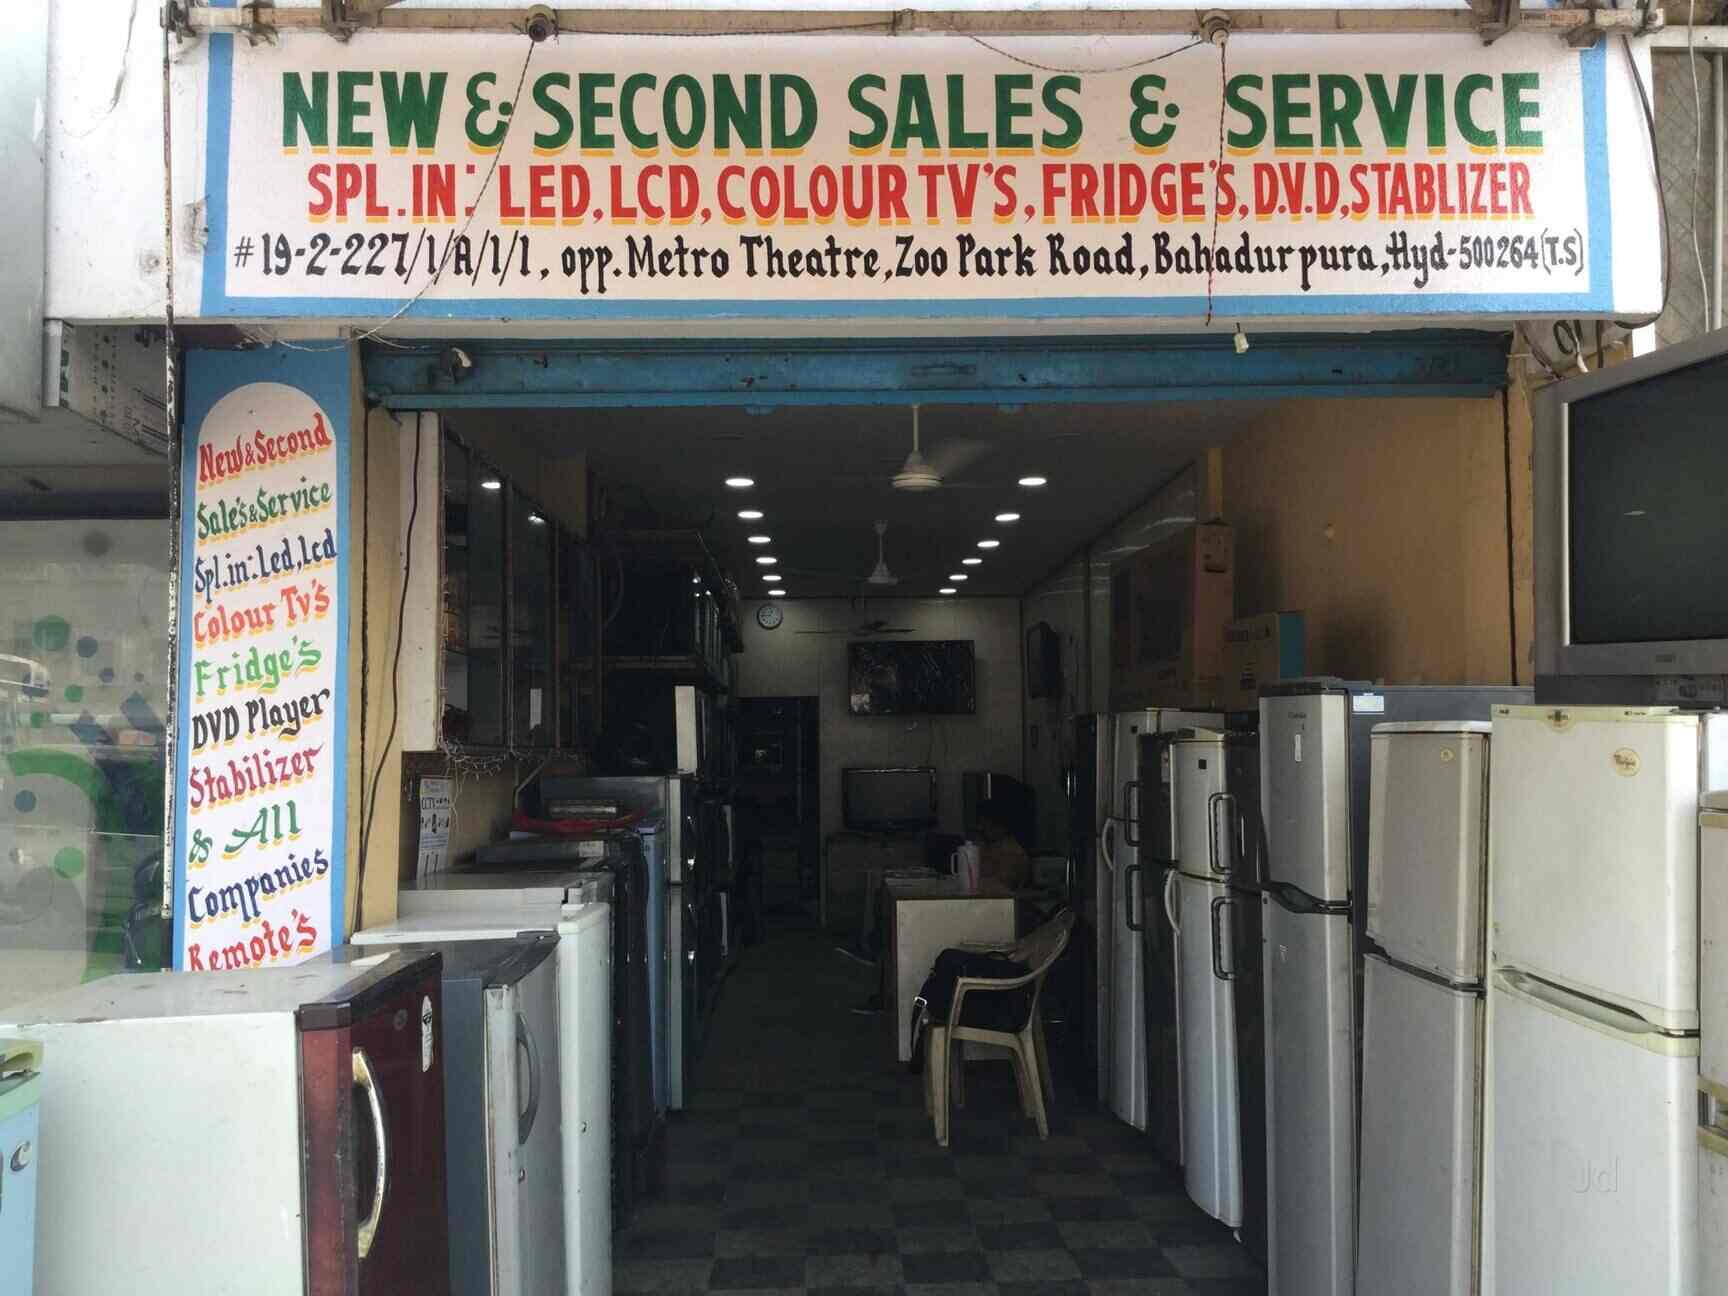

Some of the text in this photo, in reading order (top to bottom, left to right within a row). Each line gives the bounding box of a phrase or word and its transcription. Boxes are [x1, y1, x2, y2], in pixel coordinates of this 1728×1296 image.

[282, 71, 1541, 150] NEW & SECOND SALES & SERVICE
[717, 164, 909, 220] COLOUR
[1351, 161, 1534, 214] STABLIZER
[625, 234, 729, 278] Metro
[895, 235, 948, 277] Zoo
[956, 233, 1037, 278] Park
[194, 578, 330, 642] Colour Tv's
[195, 635, 321, 696] Fridge's
[191, 688, 330, 751] DVD Player
[189, 743, 324, 808] Stabilizer
[188, 800, 302, 864] & All
[188, 848, 329, 923] Companies
